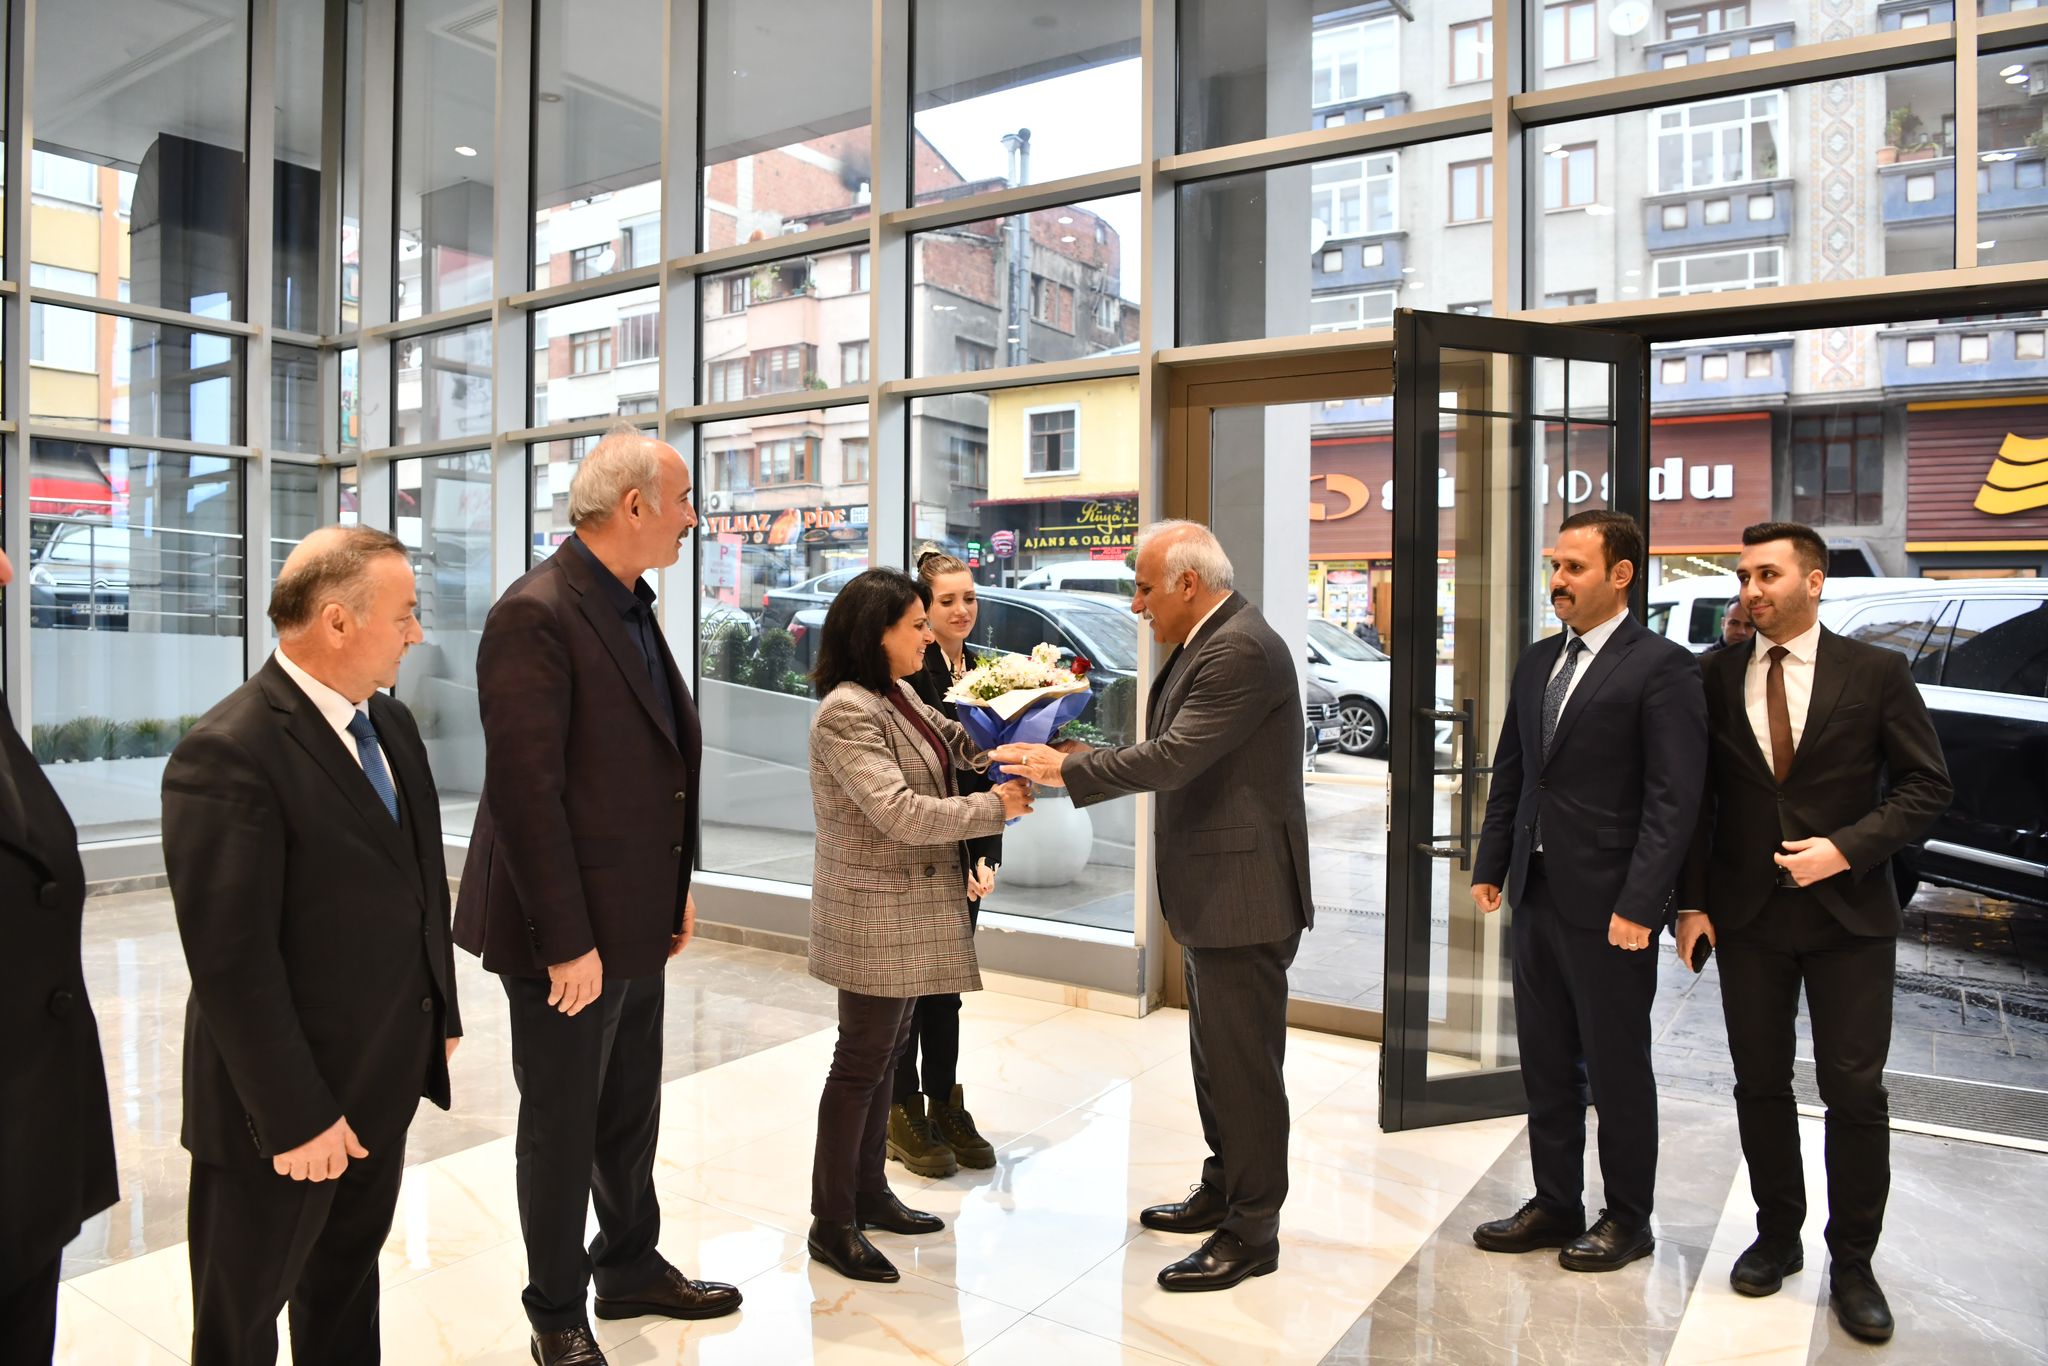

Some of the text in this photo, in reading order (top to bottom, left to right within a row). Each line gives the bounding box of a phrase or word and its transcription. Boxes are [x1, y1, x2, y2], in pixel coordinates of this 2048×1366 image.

[708, 507, 847, 533] YILMAZ PİDE
[1077, 500, 1122, 535] Rüya
[1024, 537, 1065, 549] AJANS
[1069, 536, 1079, 546] &
